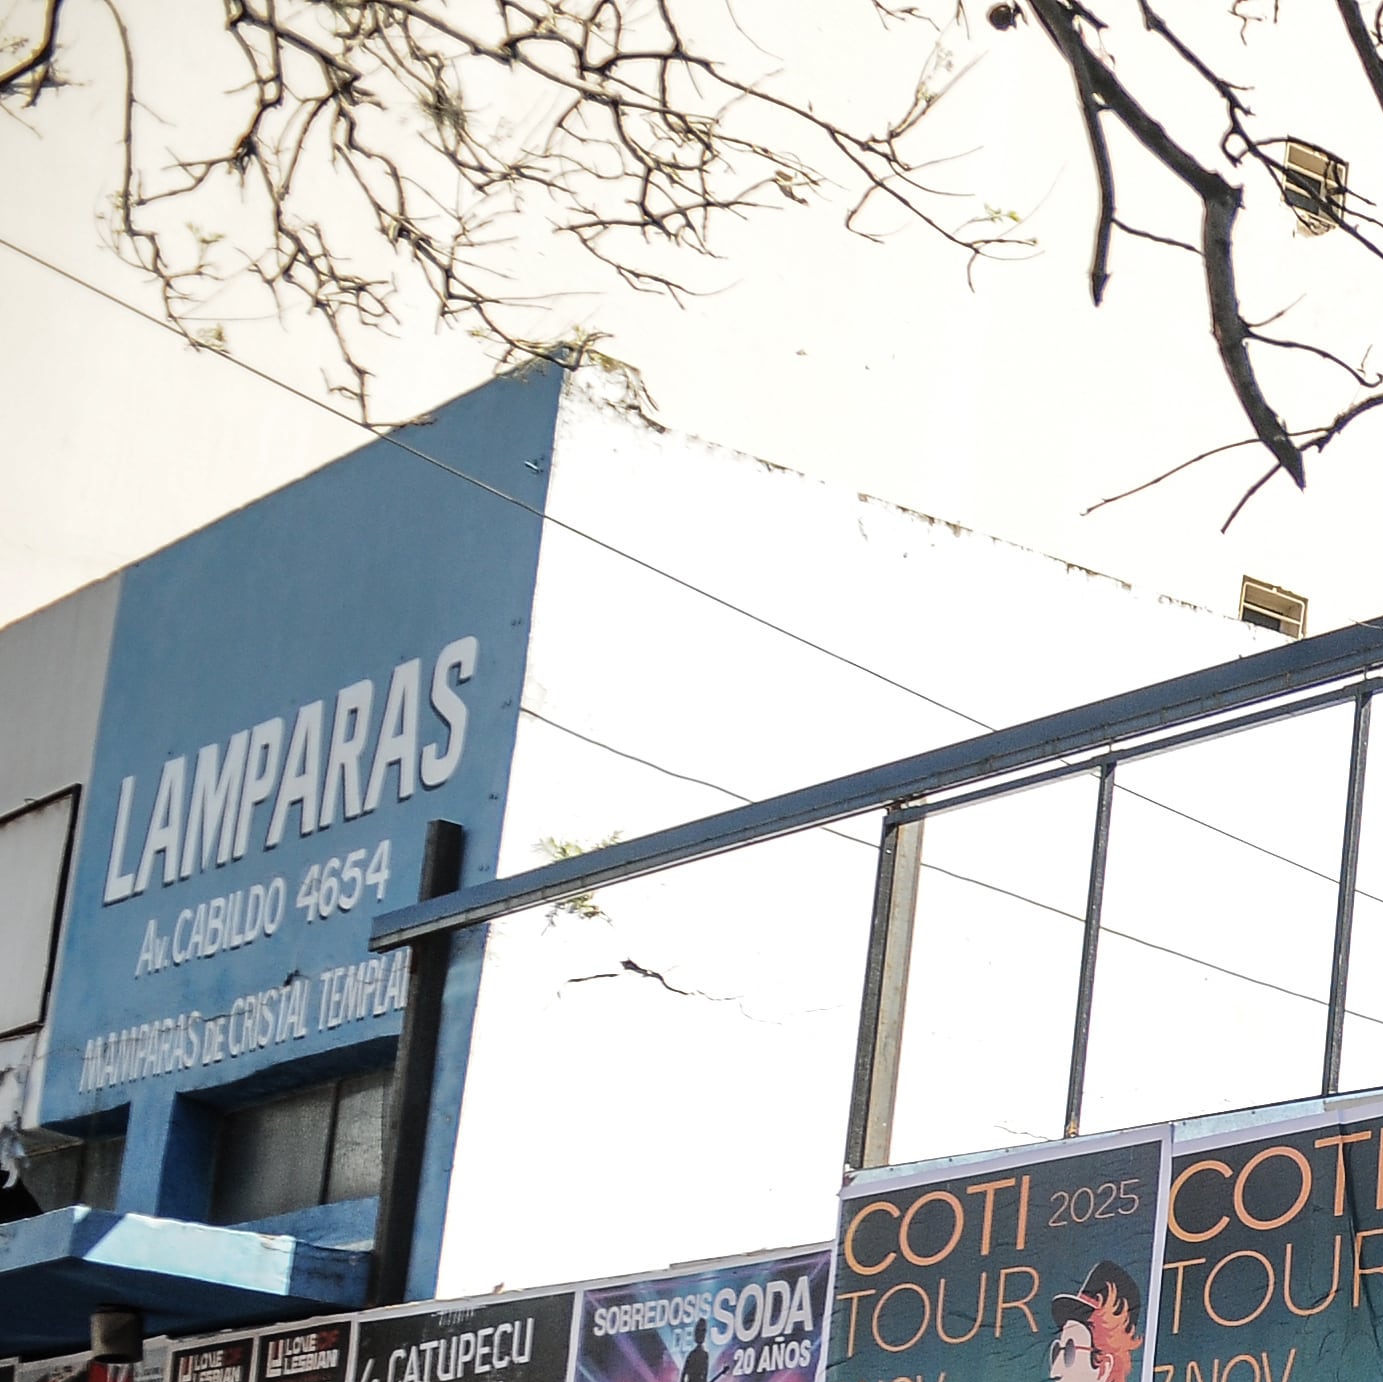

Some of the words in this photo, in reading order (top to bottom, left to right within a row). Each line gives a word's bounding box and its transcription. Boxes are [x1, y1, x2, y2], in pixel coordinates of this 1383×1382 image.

[104, 636, 478, 906] LAMPARAS
[172, 877, 285, 965] CABILDO
[297, 840, 391, 924] 4654
[79, 1014, 201, 1094] MAMPARAS
[202, 1022, 224, 1064] DE
[228, 980, 312, 1058] CRISTAL
[844, 1175, 1030, 1275] COTI
[1048, 1178, 1140, 1228] 2025
[594, 1293, 713, 1337] SOBREDOSIS
[711, 1276, 814, 1346] SODA
[836, 1266, 1041, 1357] TOUR
[283, 1350, 338, 1373] LESBIAN
